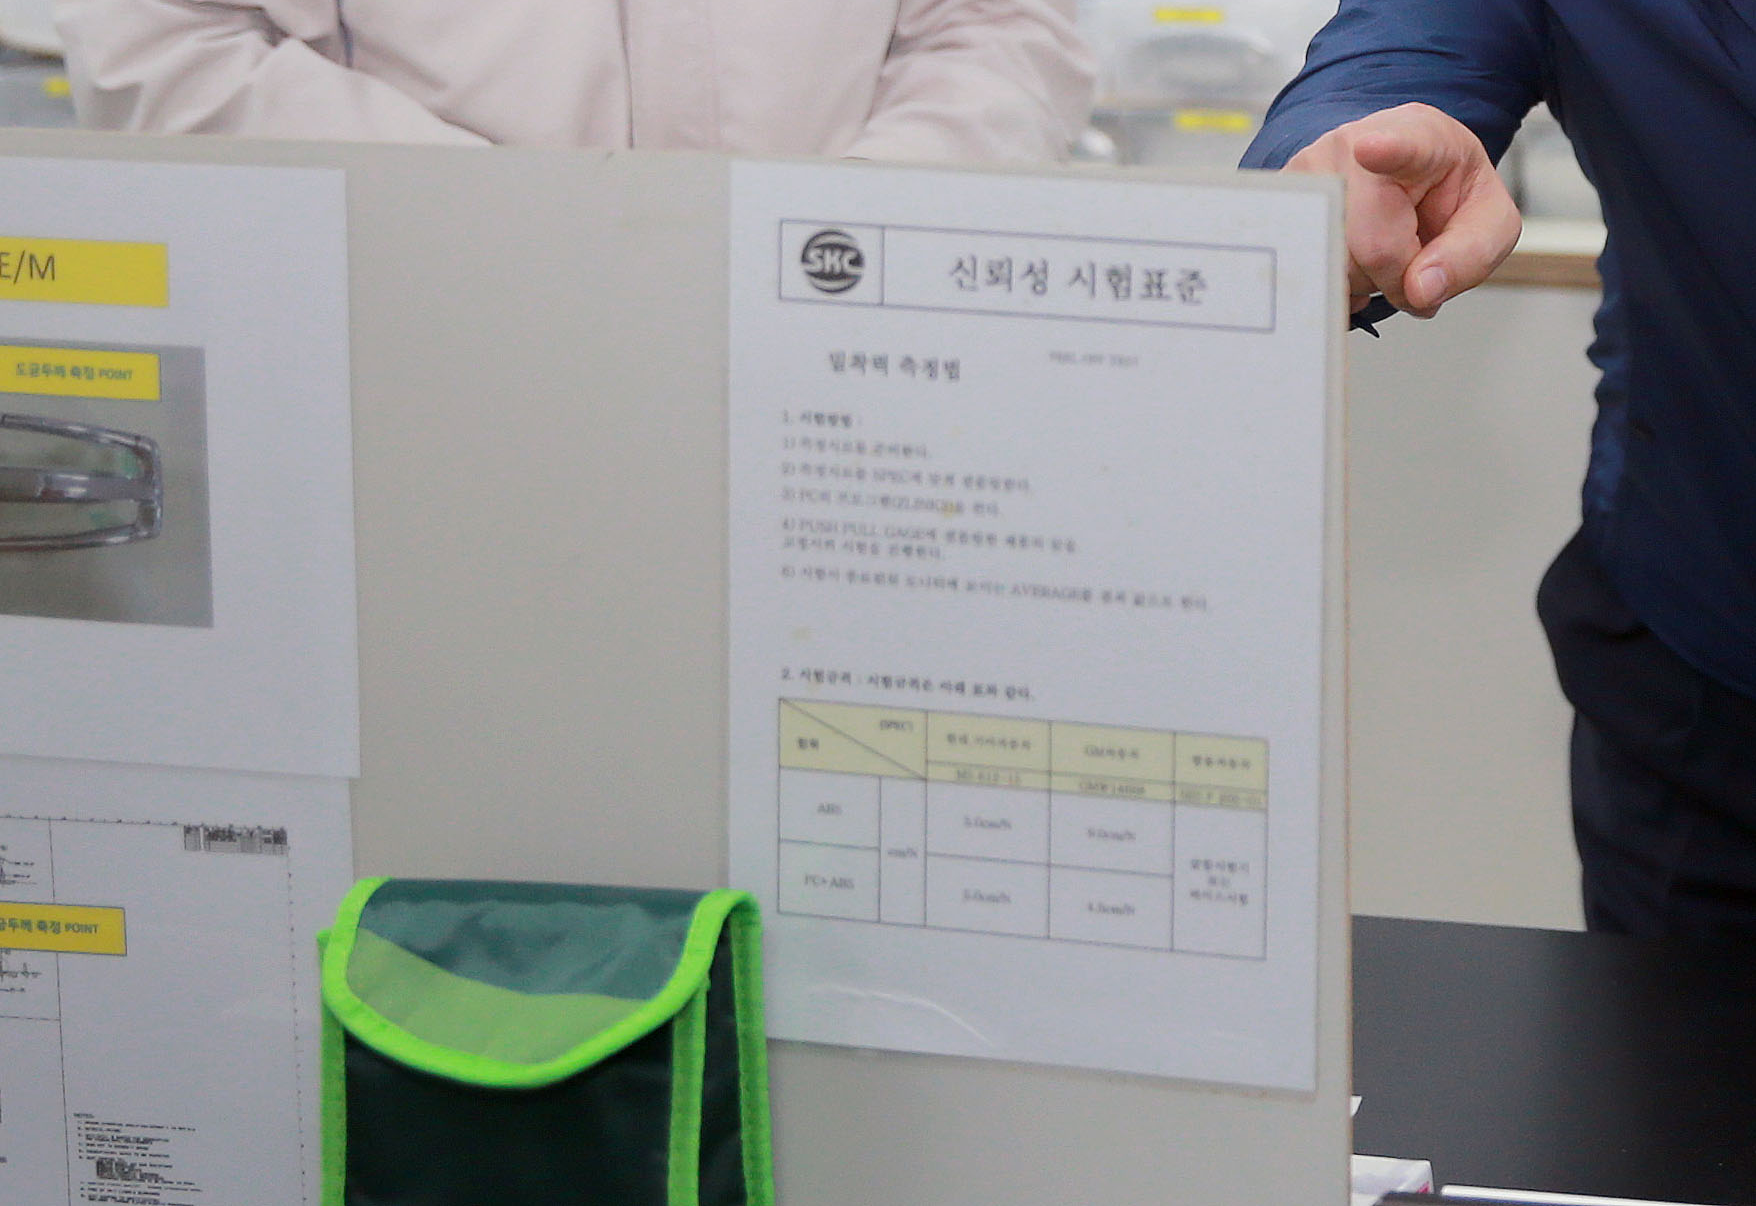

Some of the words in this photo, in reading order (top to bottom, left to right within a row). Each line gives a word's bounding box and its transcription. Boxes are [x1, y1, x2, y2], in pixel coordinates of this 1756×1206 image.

[950, 255, 1048, 295] 신뢰성
[1069, 260, 1207, 304] 시험표준
[70, 365, 94, 381] 측정
[99, 368, 132, 380] POINT
[64, 922, 98, 934] POINT
